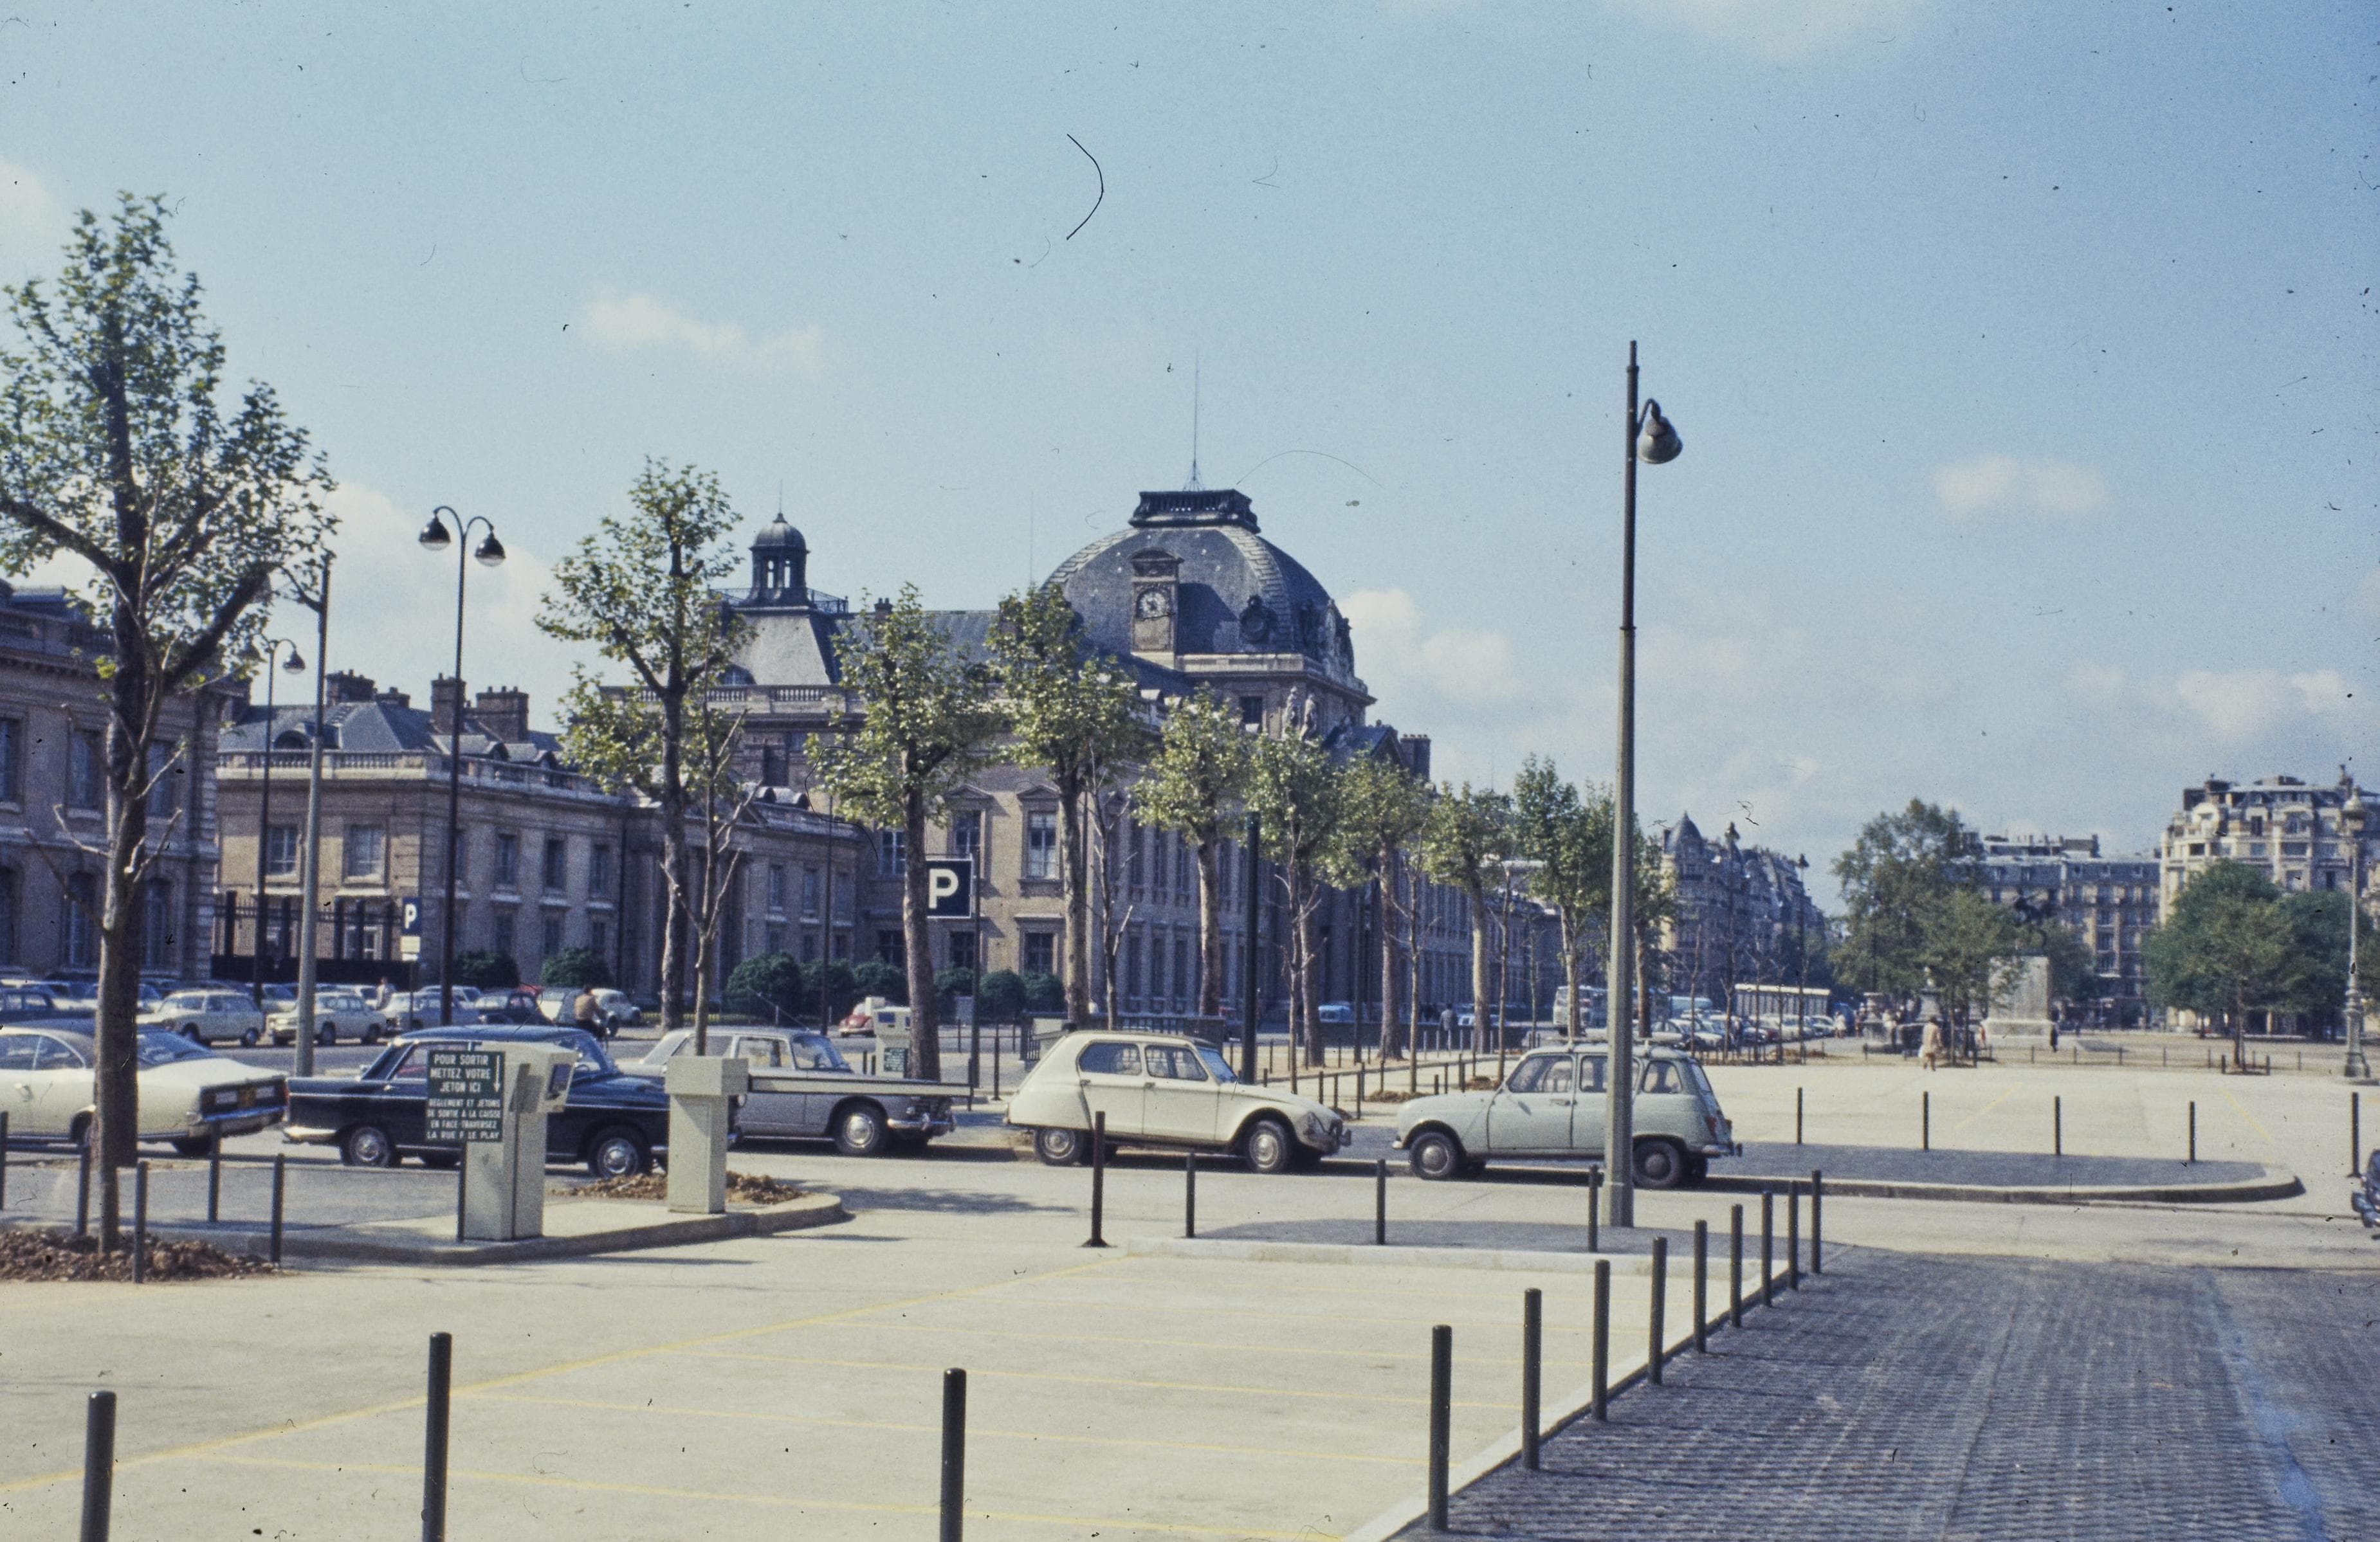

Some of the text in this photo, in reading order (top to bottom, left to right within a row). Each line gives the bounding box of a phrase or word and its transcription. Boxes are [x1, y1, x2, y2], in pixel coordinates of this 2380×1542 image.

[929, 868, 958, 909] P
[405, 903, 417, 929] P
[434, 1054, 489, 1066] POUR SORTIR
[430, 1068, 491, 1080] METTEZ VOTRE
[439, 1082, 481, 1093] JETON ICI
[480, 1130, 500, 1139] PLAY
